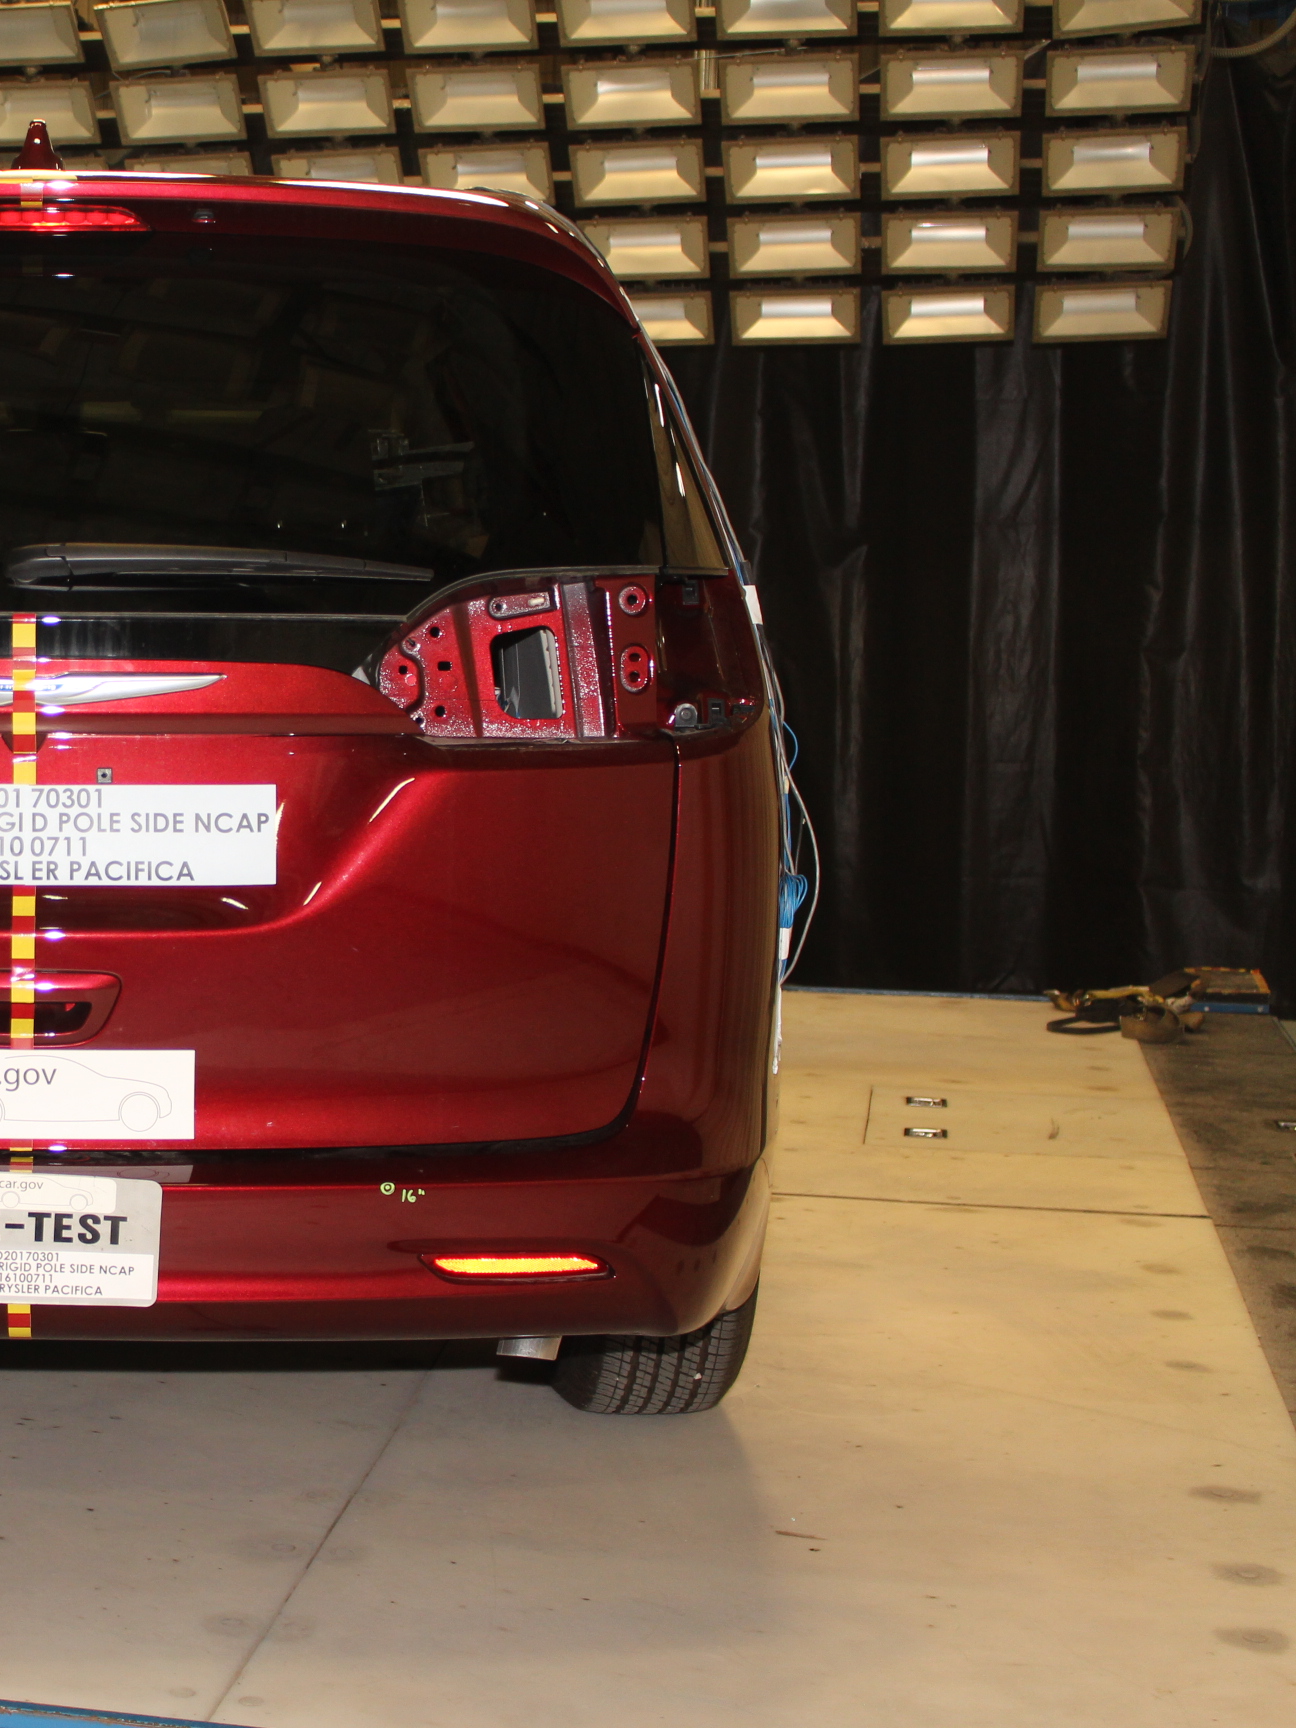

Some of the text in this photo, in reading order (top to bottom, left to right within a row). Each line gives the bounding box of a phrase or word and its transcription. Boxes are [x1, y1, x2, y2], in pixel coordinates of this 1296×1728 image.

[58, 812, 122, 833] POLE
[130, 812, 185, 834] SIDE
[194, 812, 270, 834] NCAP
[69, 860, 195, 882] PACIFICA
[36, 1262, 65, 1273] POLE
[69, 1263, 95, 1274] SIDE
[99, 1264, 135, 1276] NCAP
[44, 1284, 103, 1296] PACIFICA
